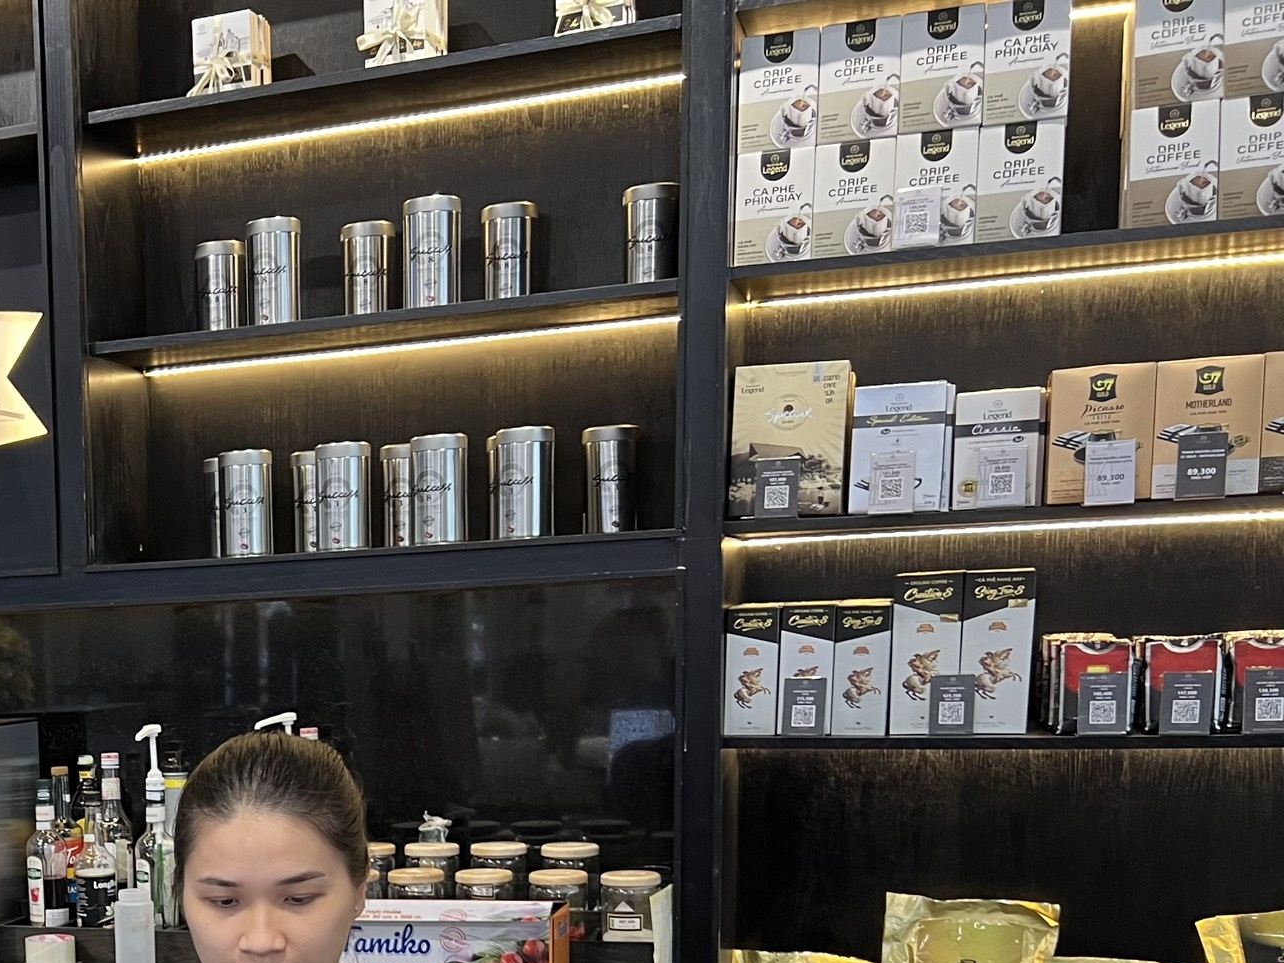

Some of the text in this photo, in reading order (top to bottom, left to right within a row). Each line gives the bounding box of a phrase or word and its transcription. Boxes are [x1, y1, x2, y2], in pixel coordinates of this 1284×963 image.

[1015, 12, 1042, 23] Legend
[1162, 16, 1195, 28] DRIP
[929, 22, 957, 33] Legend
[1151, 24, 1206, 40] COFFEE
[848, 34, 874, 46] Legend
[766, 46, 792, 57] Legend
[927, 44, 957, 55] DRIP
[995, 47, 1026, 59] PHIN
[845, 56, 874, 67] DRIP
[917, 51, 968, 66] COFFEE
[763, 67, 792, 79] DRIP
[834, 64, 884, 78] COFFEE
[754, 75, 802, 89] COFFEE
[1252, 108, 1281, 120] Legend
[1160, 120, 1189, 130] Legend
[1007, 137, 1034, 147] Legend
[1249, 132, 1282, 143] DRIP
[923, 145, 950, 155] Legend
[1158, 142, 1190, 153] DRIP
[1237, 140, 1284, 155] COFFE
[841, 156, 867, 166] Legend
[1146, 150, 1201, 164] COFFEE
[1004, 159, 1035, 169] DRIP
[763, 165, 788, 175] Legend
[920, 166, 950, 176] DRIP
[993, 166, 1045, 180] COFFEE
[839, 177, 868, 187] DRIP
[909, 174, 960, 186] COFFEE
[828, 185, 878, 197] COFFEE
[745, 197, 772, 206] PHIN
[1199, 371, 1222, 384] G7
[1092, 377, 1115, 391] G7
[741, 387, 765, 395] Legend
[885, 404, 912, 413] Legend
[1185, 398, 1232, 409] MOTHERLAND
[983, 411, 1012, 421] Legend
[1080, 404, 1125, 419] Picasso
[972, 424, 1021, 435] Classic
[1187, 467, 1217, 476] 89,300
